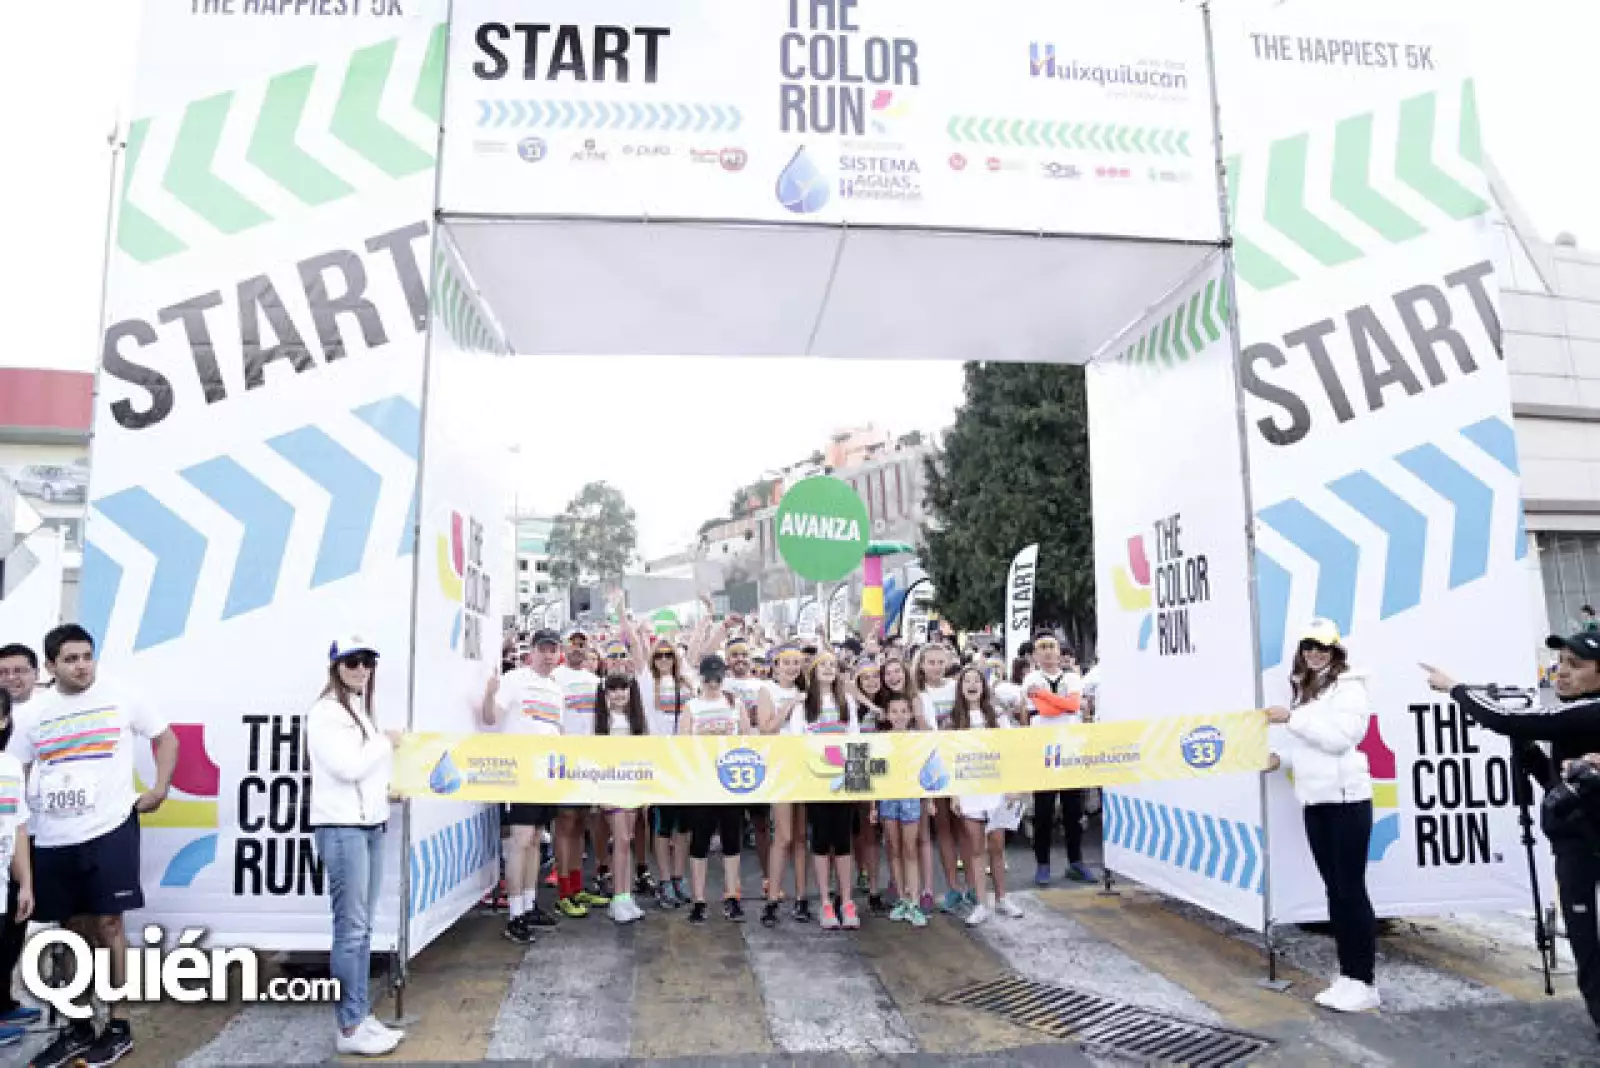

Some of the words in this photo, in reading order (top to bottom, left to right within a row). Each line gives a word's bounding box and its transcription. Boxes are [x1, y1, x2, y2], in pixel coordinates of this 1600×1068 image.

[784, 0, 860, 32] THE
[472, 21, 671, 83] START
[780, 32, 920, 85] COLOR
[1250, 33, 1293, 61] THE
[1298, 37, 1399, 68] HAPPIEST
[1405, 45, 1435, 70] 5K
[780, 84, 866, 135] RUN
[839, 155, 921, 174] SISTEMA
[102, 220, 430, 430] START
[1241, 259, 1504, 446] START
[780, 512, 861, 541] AVANZA
[1154, 512, 1183, 563] THE
[1012, 562, 1033, 630] START
[1155, 555, 1210, 608] COLOR
[728, 766, 756, 788] 33
[1192, 742, 1216, 764] 33
[47, 788, 86, 809] 2096
[239, 776, 316, 833] COL
[234, 838, 325, 896] RUN
